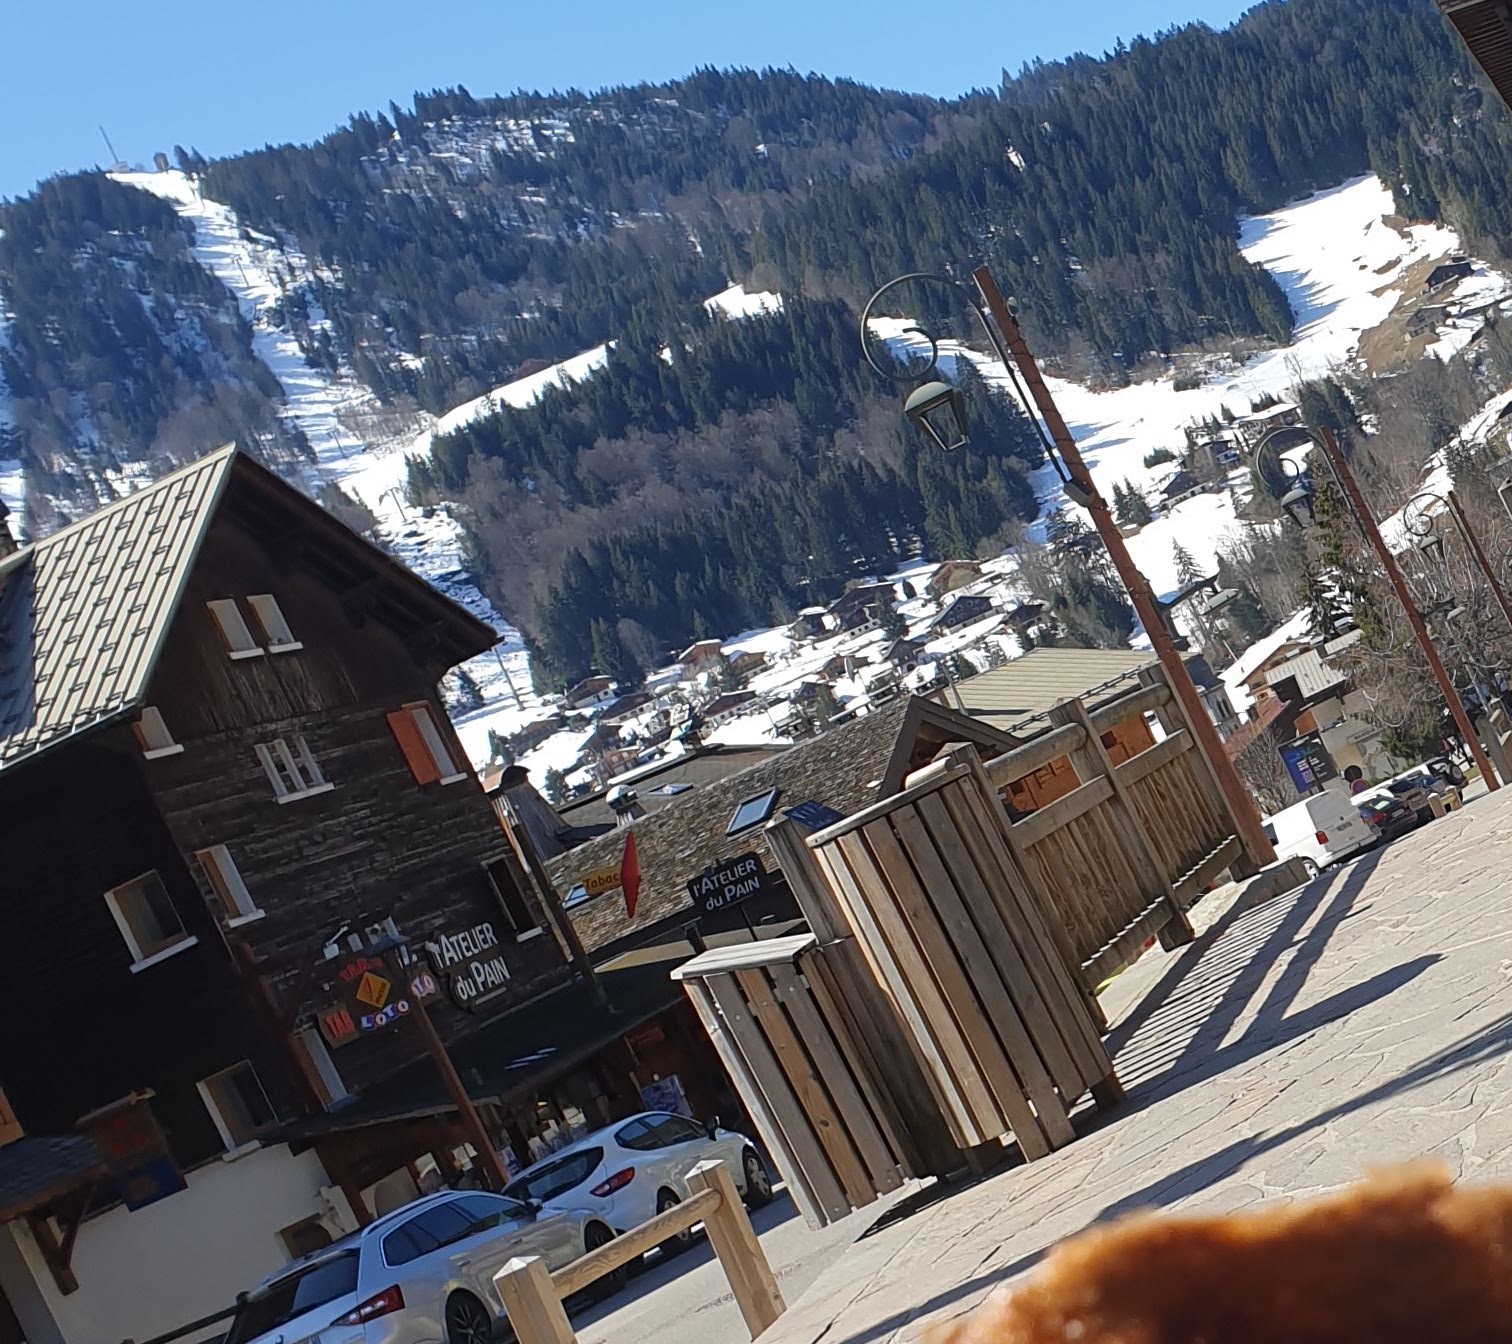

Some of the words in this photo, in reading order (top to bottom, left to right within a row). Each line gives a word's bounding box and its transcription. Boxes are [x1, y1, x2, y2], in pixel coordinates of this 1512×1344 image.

[584, 871, 619, 891] Tabac
[693, 858, 758, 898] l'ATELIER
[705, 895, 723, 911] du
[724, 876, 760, 902] PAIN
[456, 975, 477, 1001] du
[470, 956, 511, 992] PAIN
[360, 999, 410, 1030] LOTO
